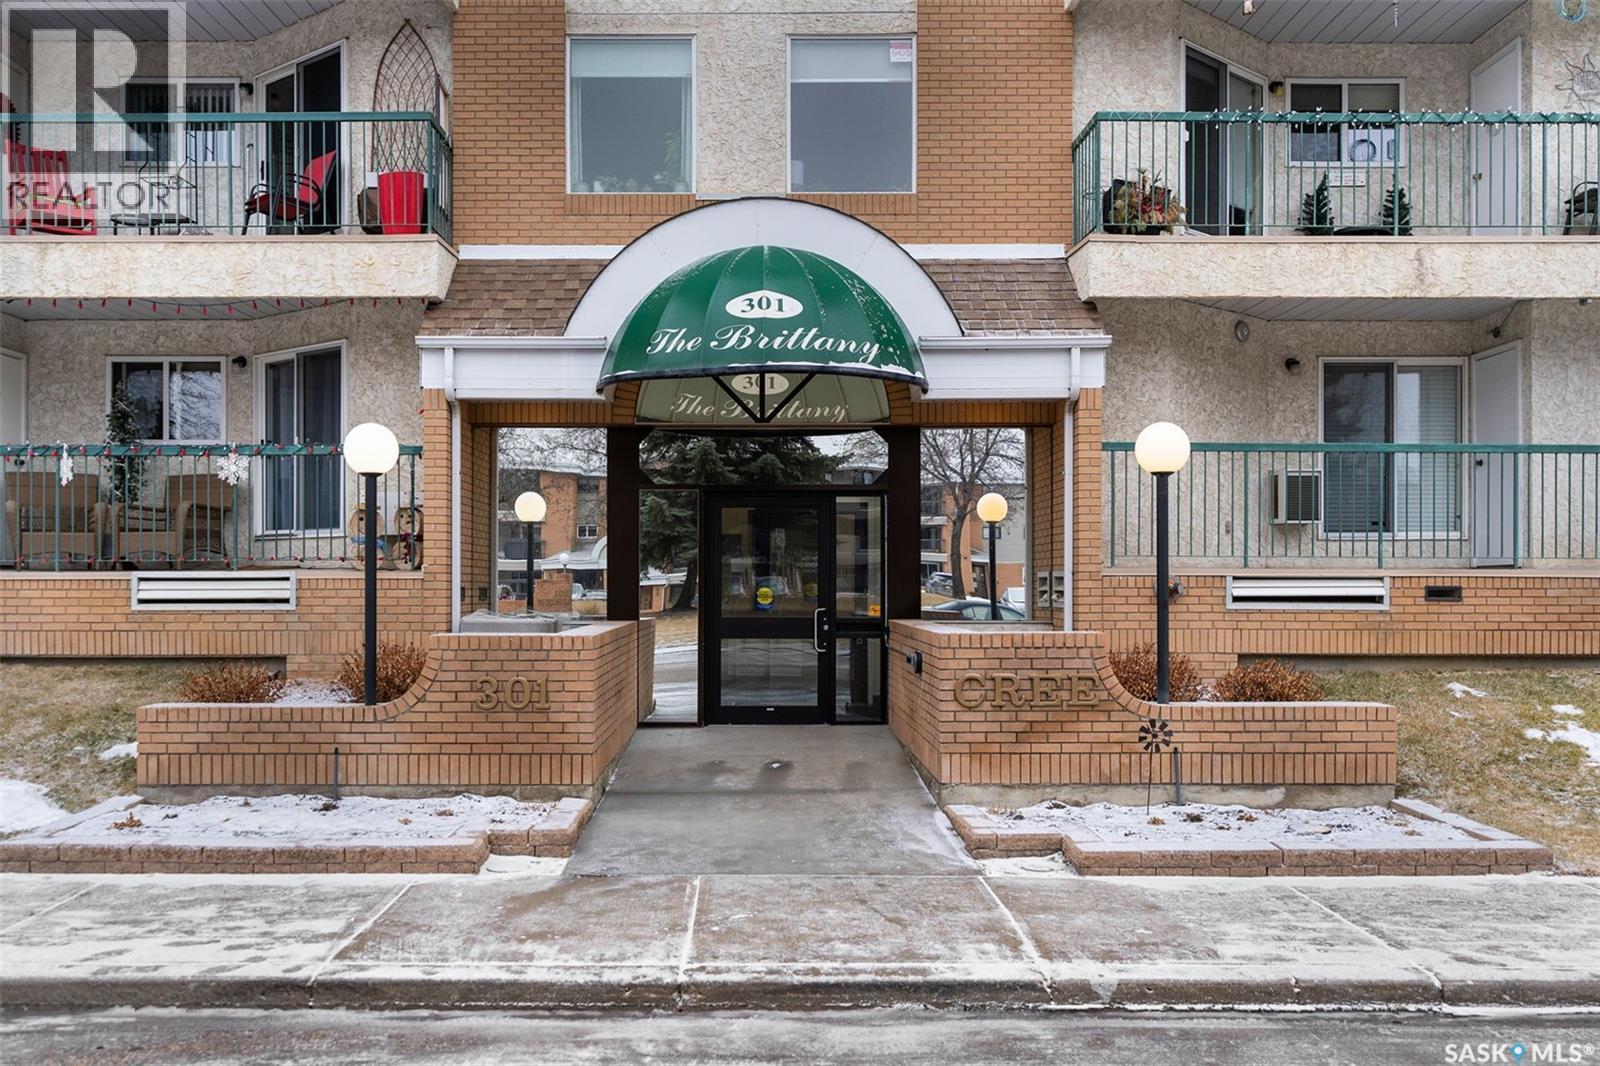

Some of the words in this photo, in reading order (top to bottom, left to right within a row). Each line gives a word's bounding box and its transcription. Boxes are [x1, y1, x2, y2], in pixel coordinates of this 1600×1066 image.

[740, 295, 785, 313] 301
[646, 327, 703, 355] The
[709, 324, 881, 364] Brittany
[670, 393, 715, 415] The
[475, 675, 551, 710] 301
[954, 672, 1101, 709] CREE
